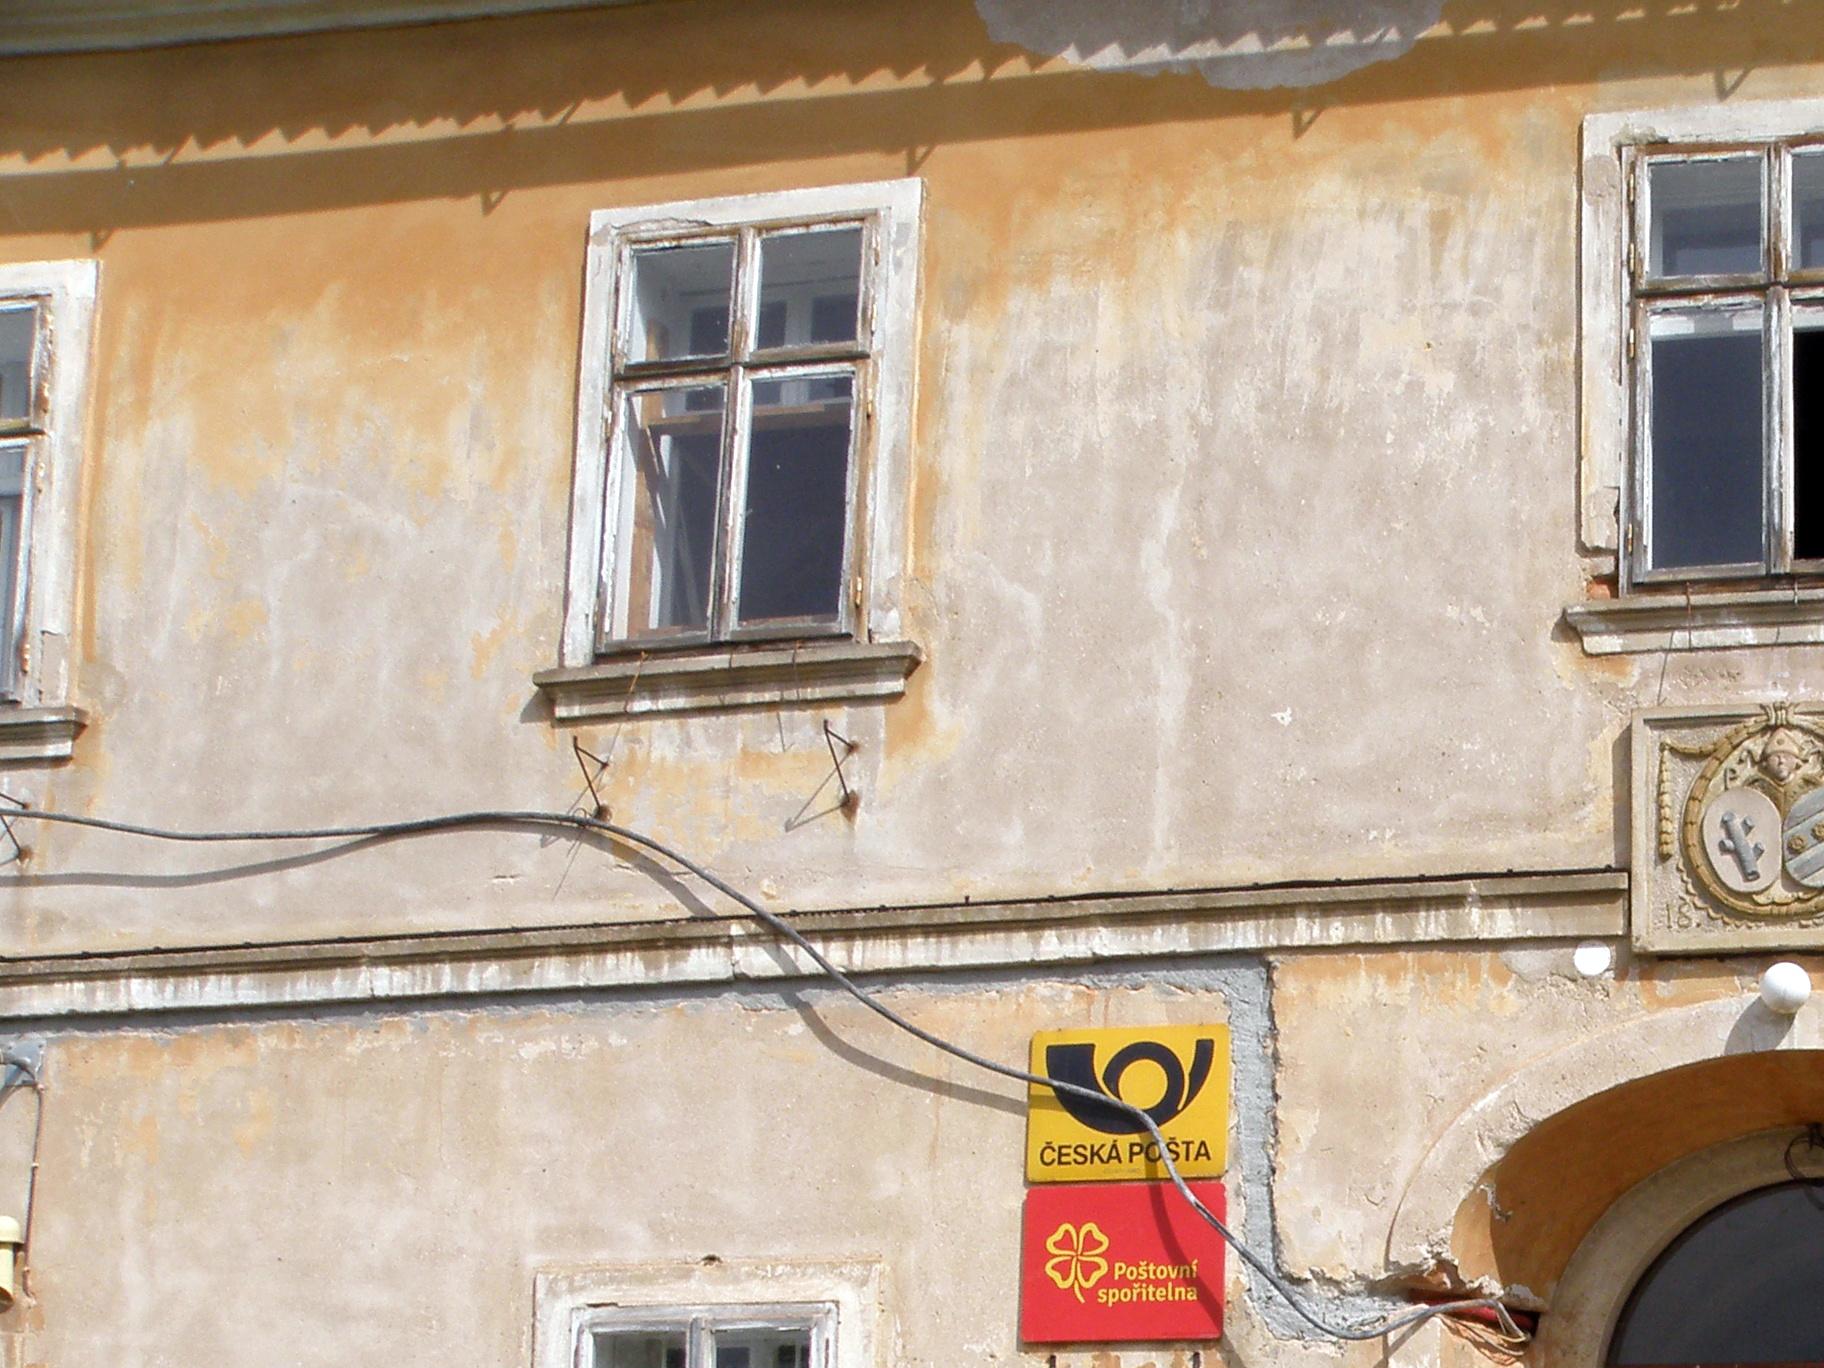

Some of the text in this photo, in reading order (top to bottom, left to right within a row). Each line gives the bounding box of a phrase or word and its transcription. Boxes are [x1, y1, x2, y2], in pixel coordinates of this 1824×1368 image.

[1039, 1137, 1212, 1167] ČESKÁ POŠTA
[1113, 1258, 1199, 1281] Poštovní
[1097, 1281, 1198, 1308] spořitelna
